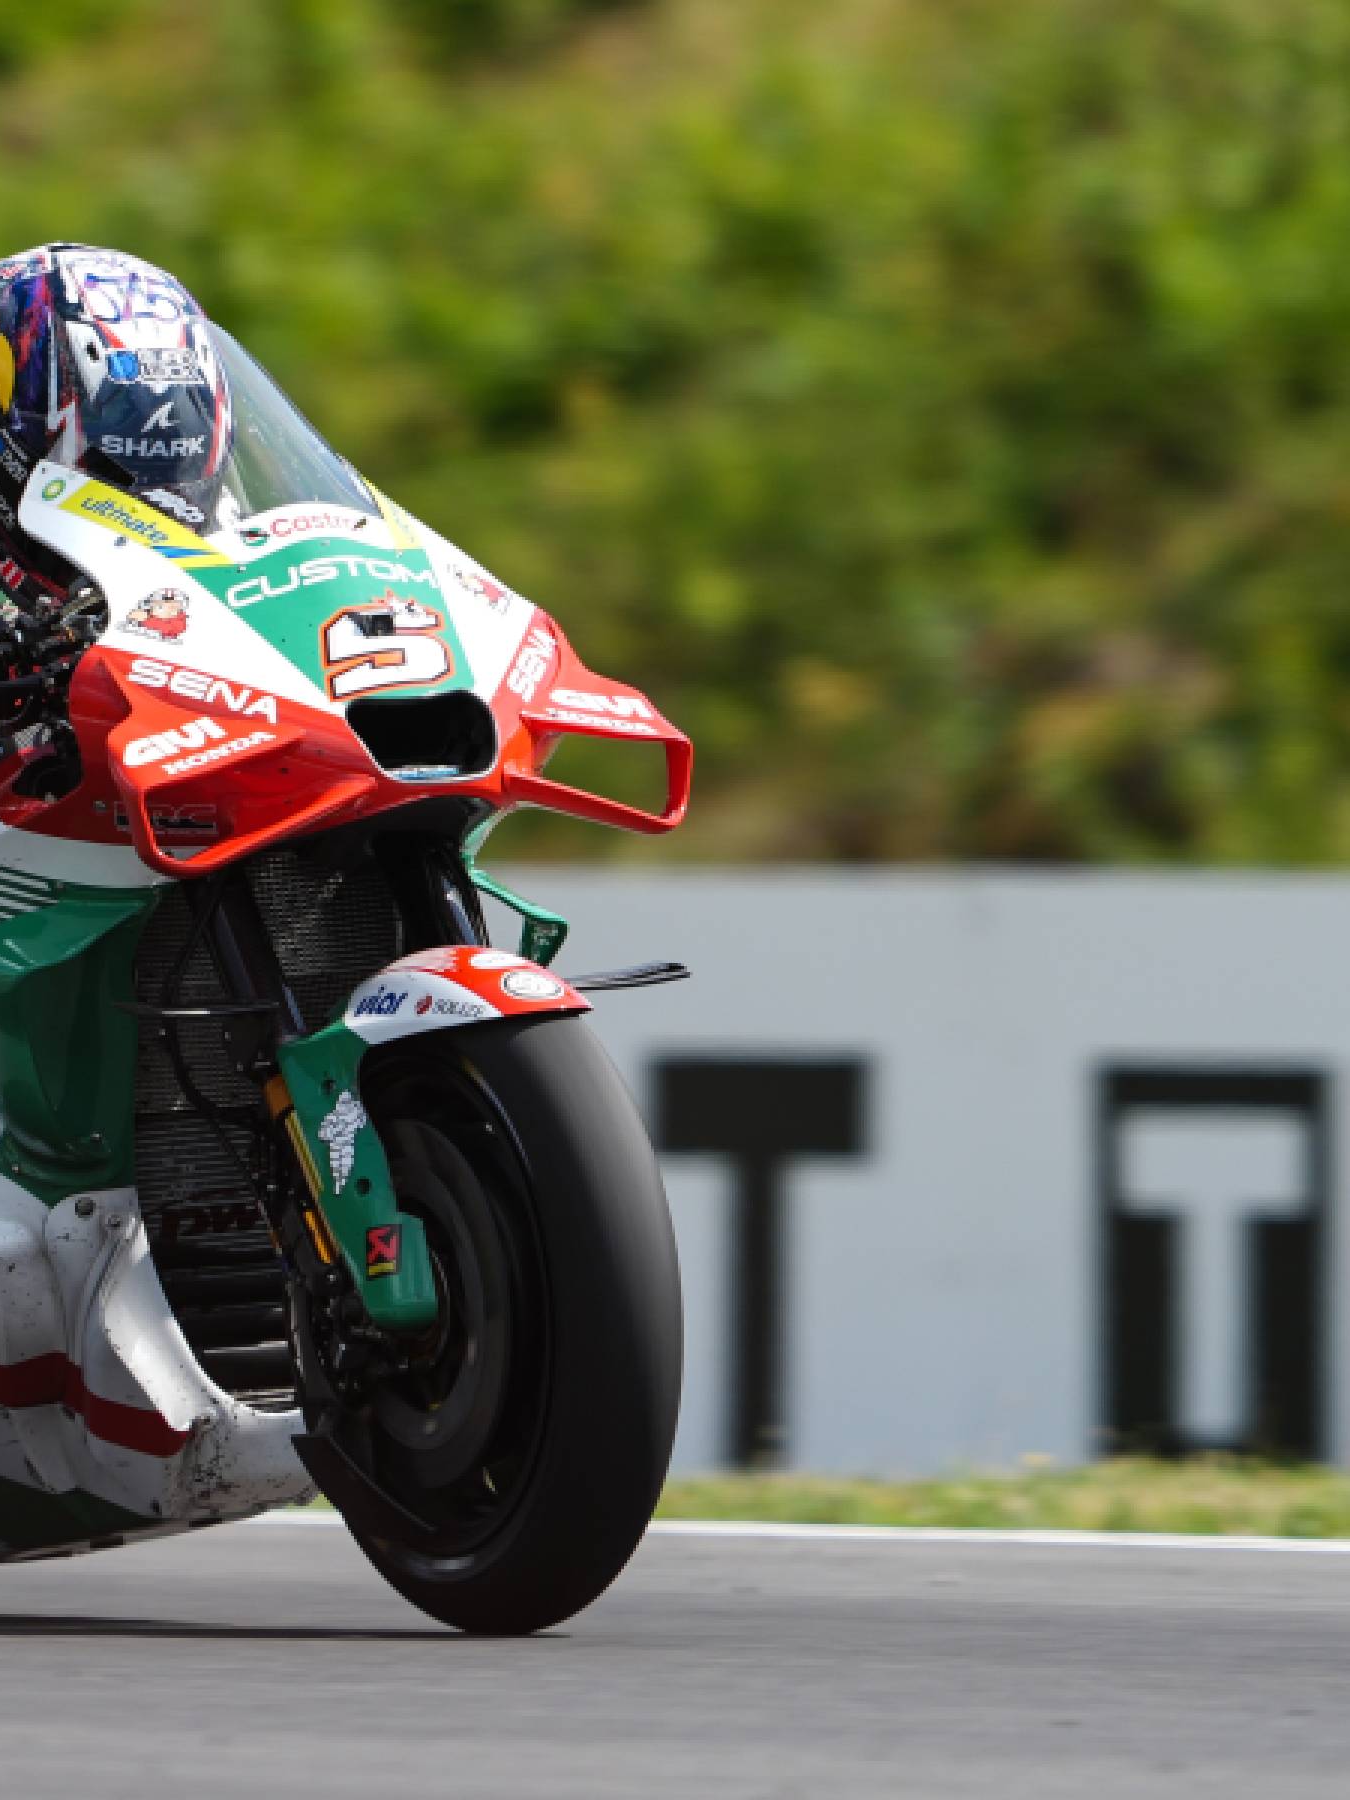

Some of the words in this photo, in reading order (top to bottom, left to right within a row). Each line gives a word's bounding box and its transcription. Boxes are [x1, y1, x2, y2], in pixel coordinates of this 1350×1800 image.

[101, 435, 205, 457] SHARK
[80, 497, 168, 545] ultimate
[270, 511, 369, 538] Castr
[226, 554, 440, 608] CUSTOM
[319, 594, 455, 702] 5
[507, 628, 559, 704] SEN
[126, 659, 278, 725] SENA
